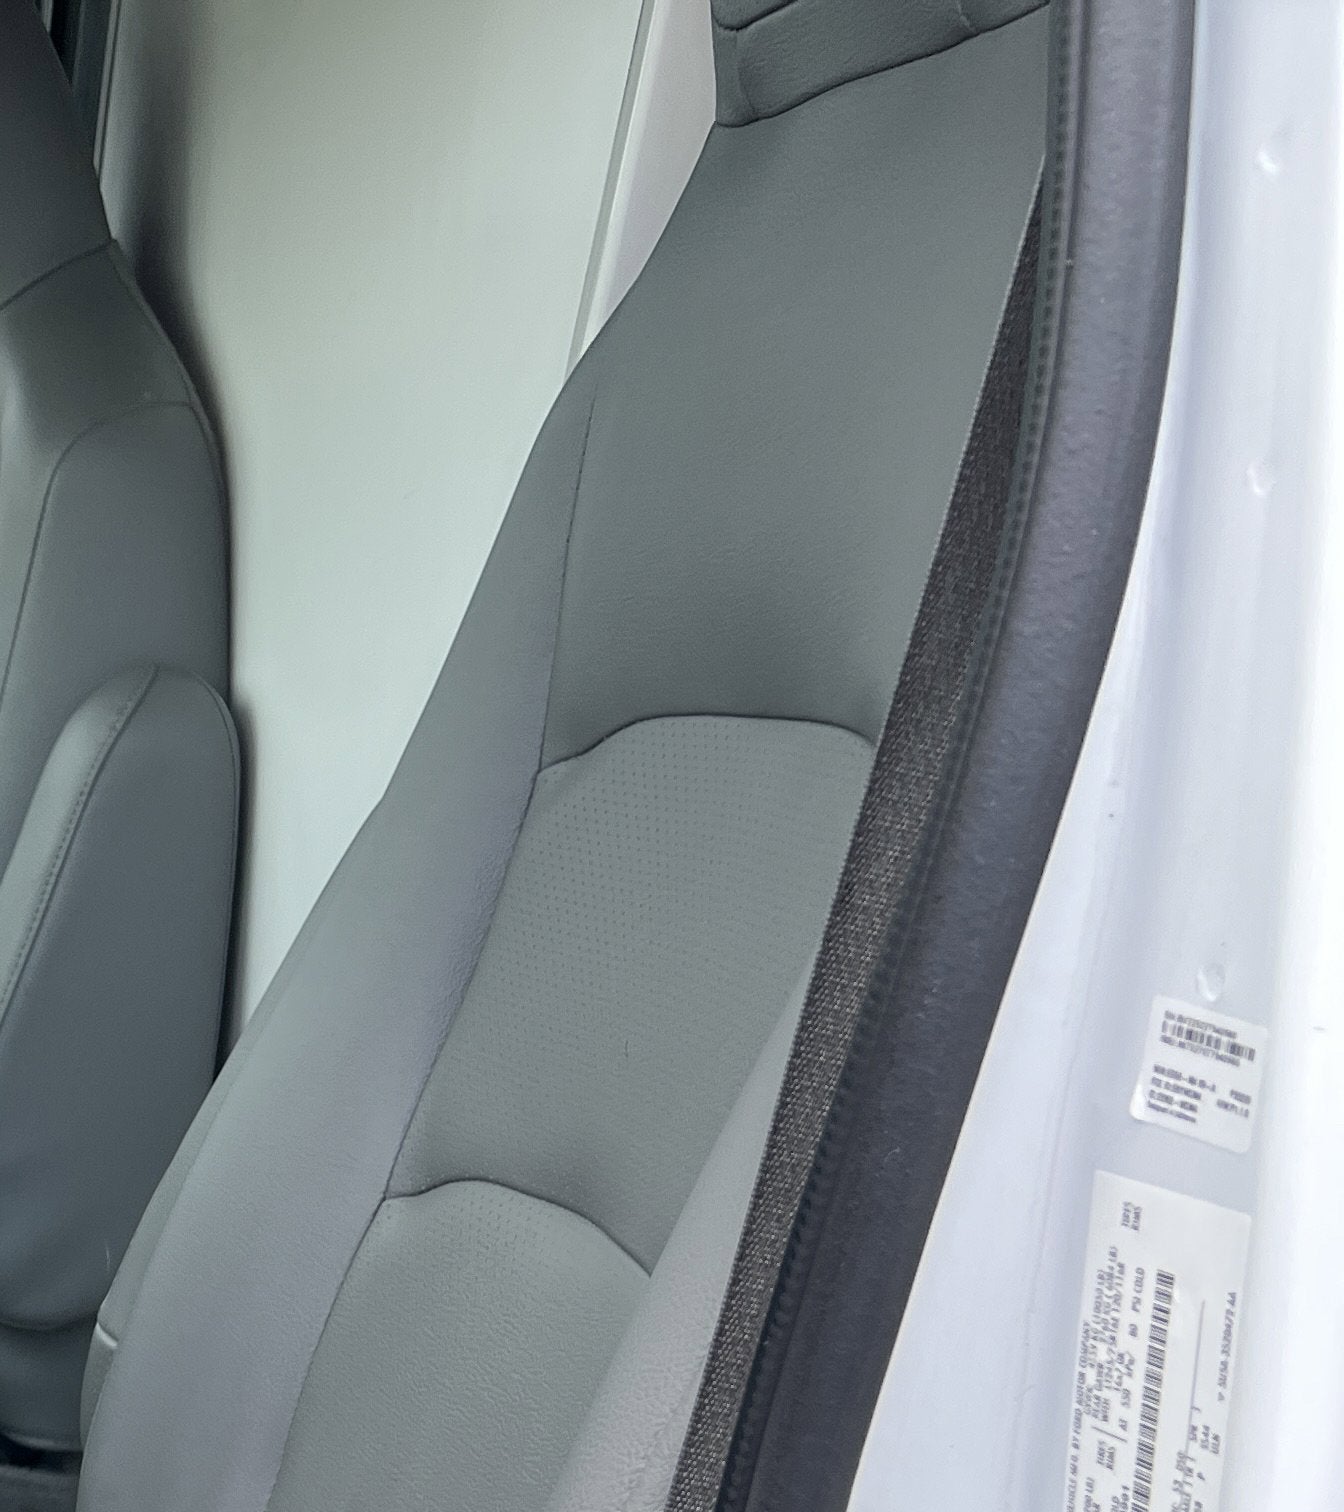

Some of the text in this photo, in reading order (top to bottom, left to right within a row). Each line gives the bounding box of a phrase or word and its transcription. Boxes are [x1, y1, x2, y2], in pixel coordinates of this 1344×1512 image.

[1078, 1319, 1090, 1369] COMPANY
[1117, 1417, 1127, 1431] AT
[1132, 1265, 1145, 1294] COLD
[1075, 1370, 1085, 1406] MOTOR
[1073, 1407, 1082, 1434] FORD
[1071, 1435, 1079, 1450] BY
